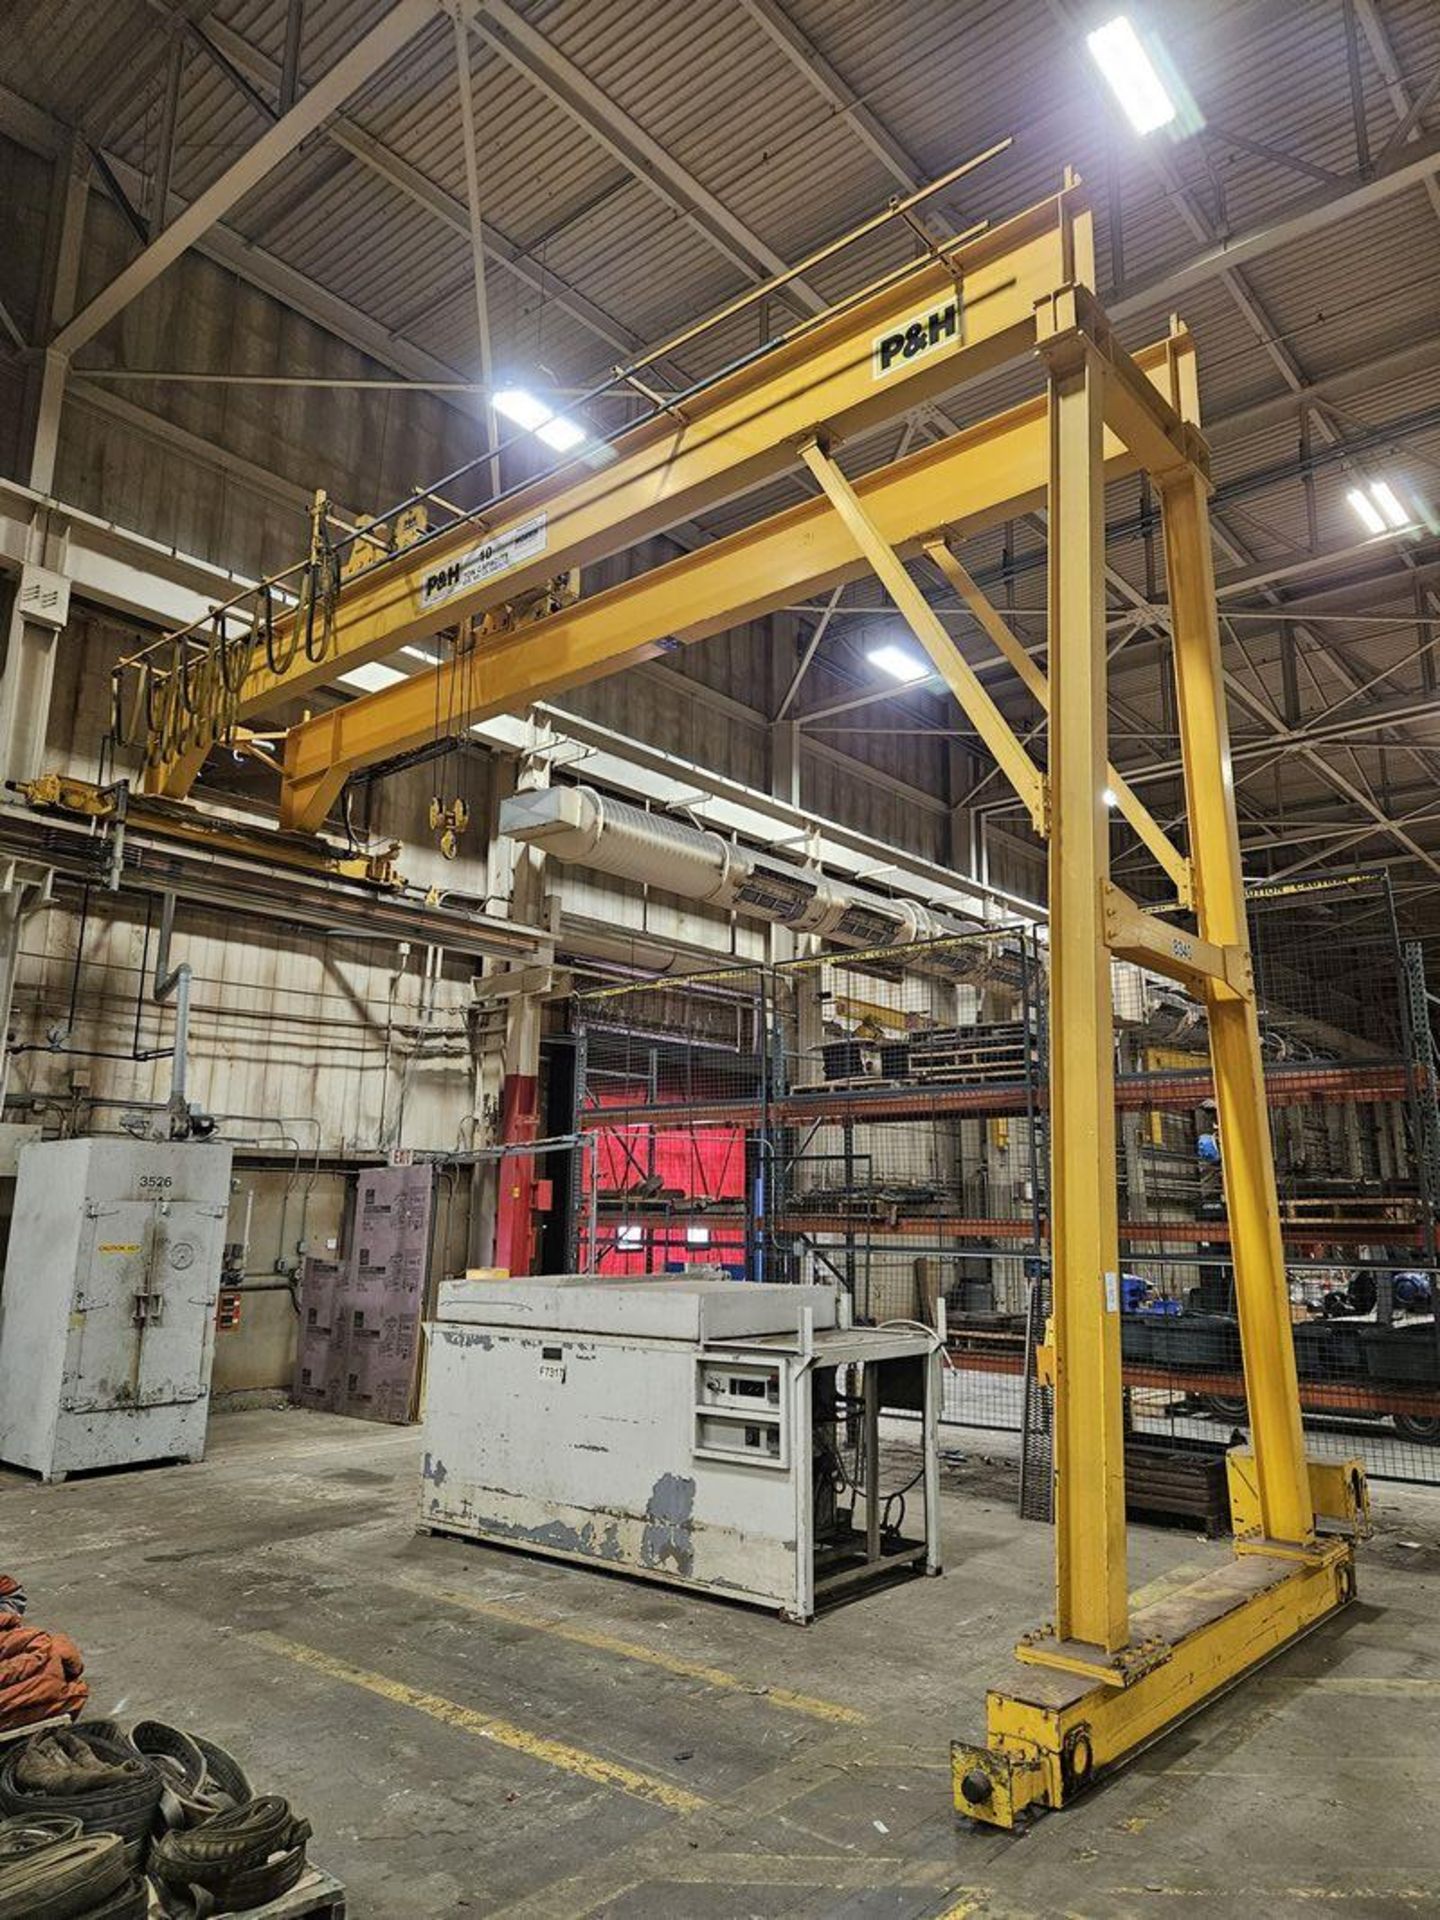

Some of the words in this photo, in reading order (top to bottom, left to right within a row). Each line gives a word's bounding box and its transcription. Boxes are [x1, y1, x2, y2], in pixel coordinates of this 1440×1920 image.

[881, 304, 955, 370] P&H
[480, 546, 493, 561] 10
[426, 562, 460, 597] P&H
[394, 1150, 409, 1164] EXIT
[139, 1176, 172, 1188] 3526
